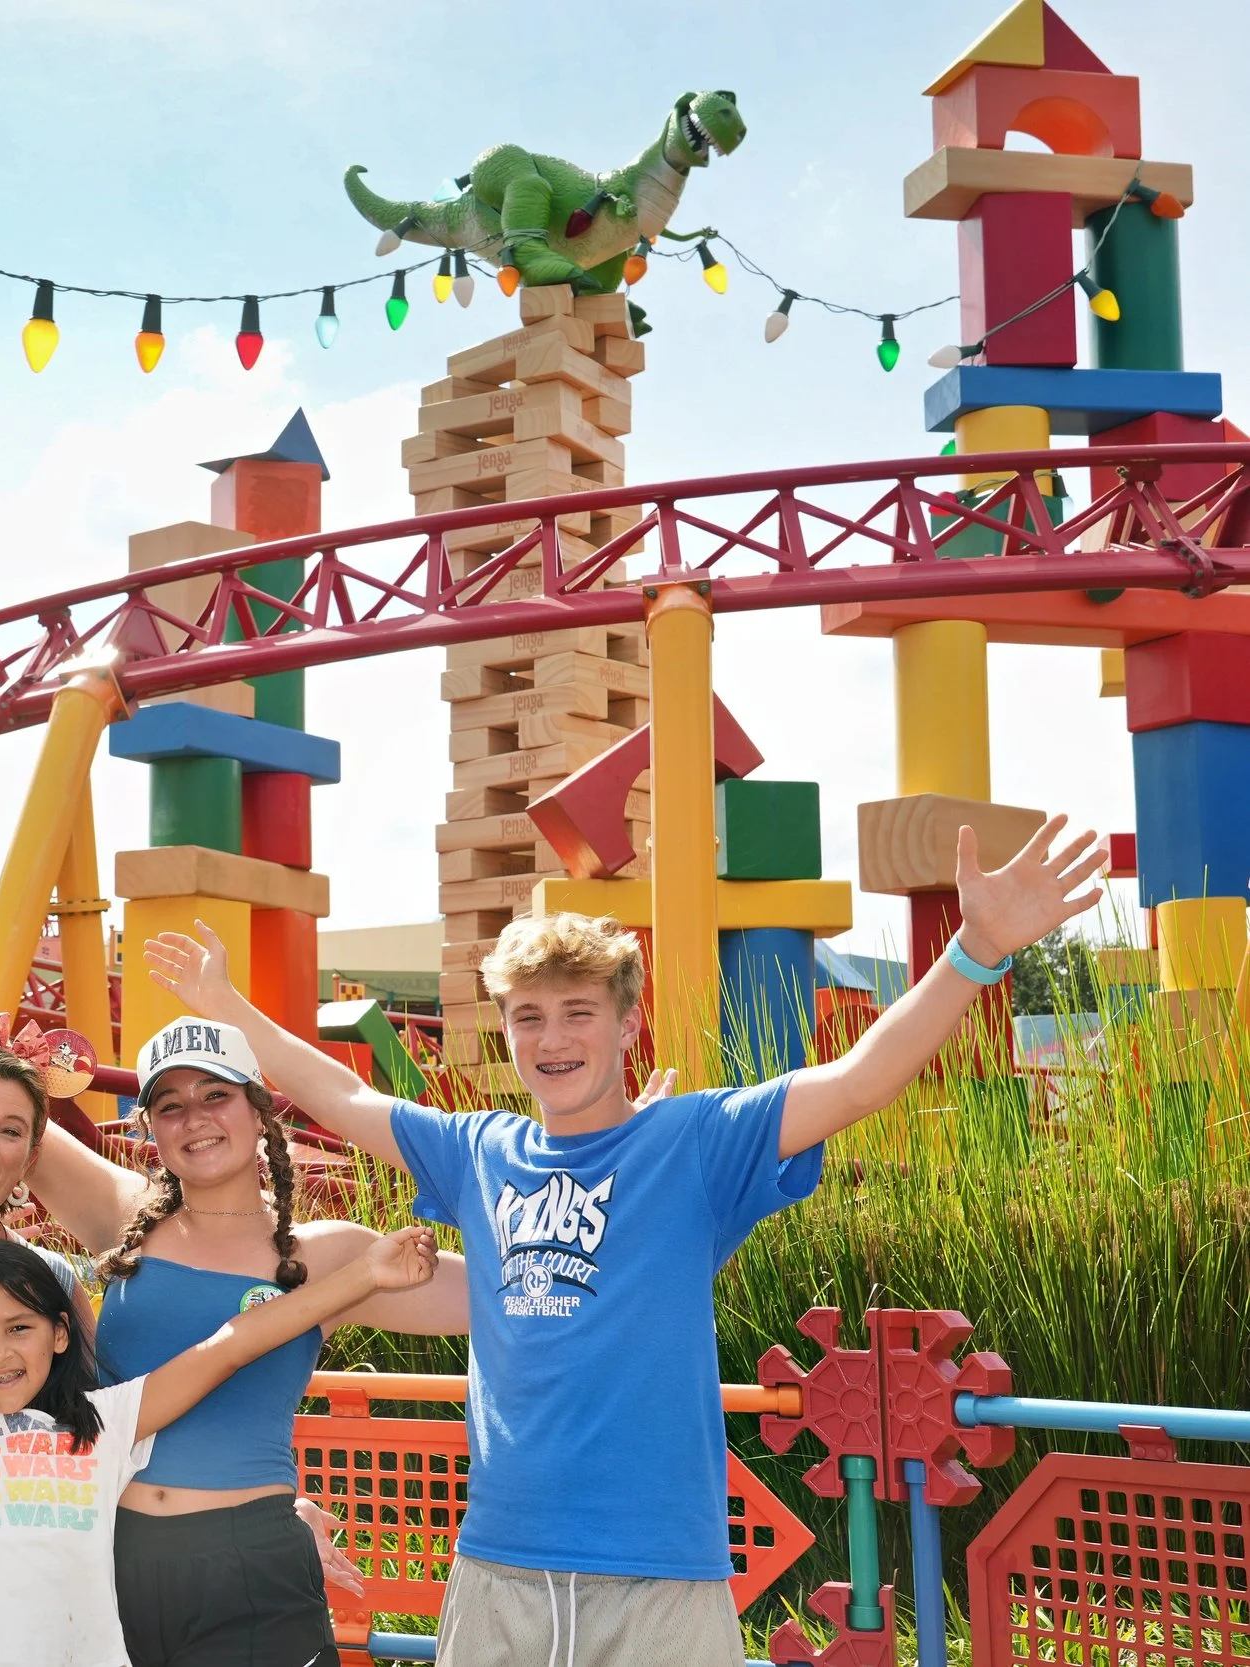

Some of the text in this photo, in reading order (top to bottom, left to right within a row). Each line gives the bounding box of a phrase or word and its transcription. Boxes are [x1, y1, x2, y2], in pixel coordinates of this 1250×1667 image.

[487, 391, 525, 417] Jenga
[477, 450, 512, 477] Jenga
[507, 571, 542, 597] Jenga
[511, 692, 544, 718] Jenga
[509, 752, 538, 779] Jenga
[499, 818, 533, 842] Jenga
[499, 879, 533, 904] Jenga
[495, 1169, 618, 1259] KINGS
[502, 1250, 600, 1285] OF THE COURT
[503, 1296, 581, 1307] REACH HIGHER
[505, 1305, 573, 1317] BASKETBALL
[2, 1456, 99, 1481] WARS
[3, 1480, 99, 1506] WARS
[4, 1504, 99, 1531] WARS
